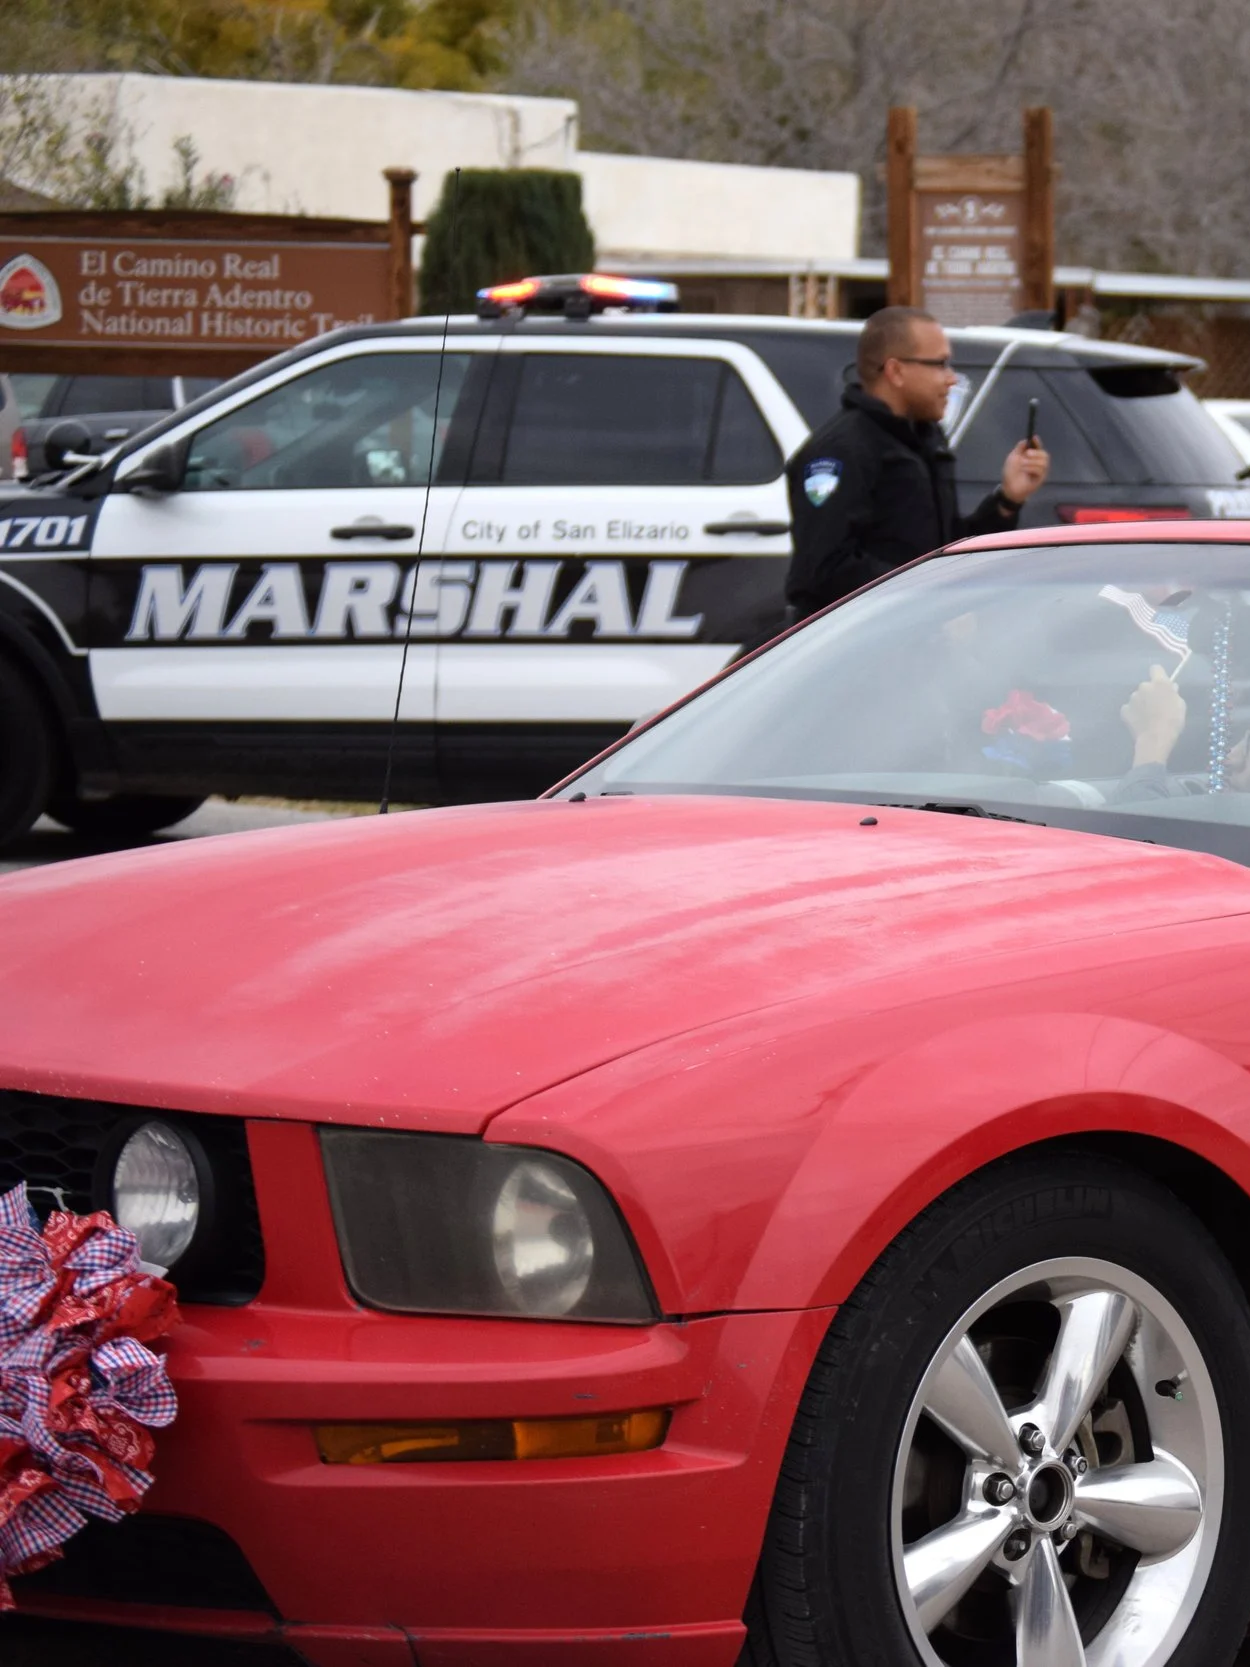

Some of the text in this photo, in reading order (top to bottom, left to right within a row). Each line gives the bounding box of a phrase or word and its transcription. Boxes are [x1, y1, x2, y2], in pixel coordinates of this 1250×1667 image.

[80, 250, 280, 280] El Camino Real
[78, 280, 313, 309] de Tierra Adentro
[80, 309, 193, 335] National
[200, 312, 304, 338] Historic
[0, 514, 88, 548] 1701
[462, 520, 690, 542] City of San Elizario
[123, 559, 705, 643] MARSHAL
